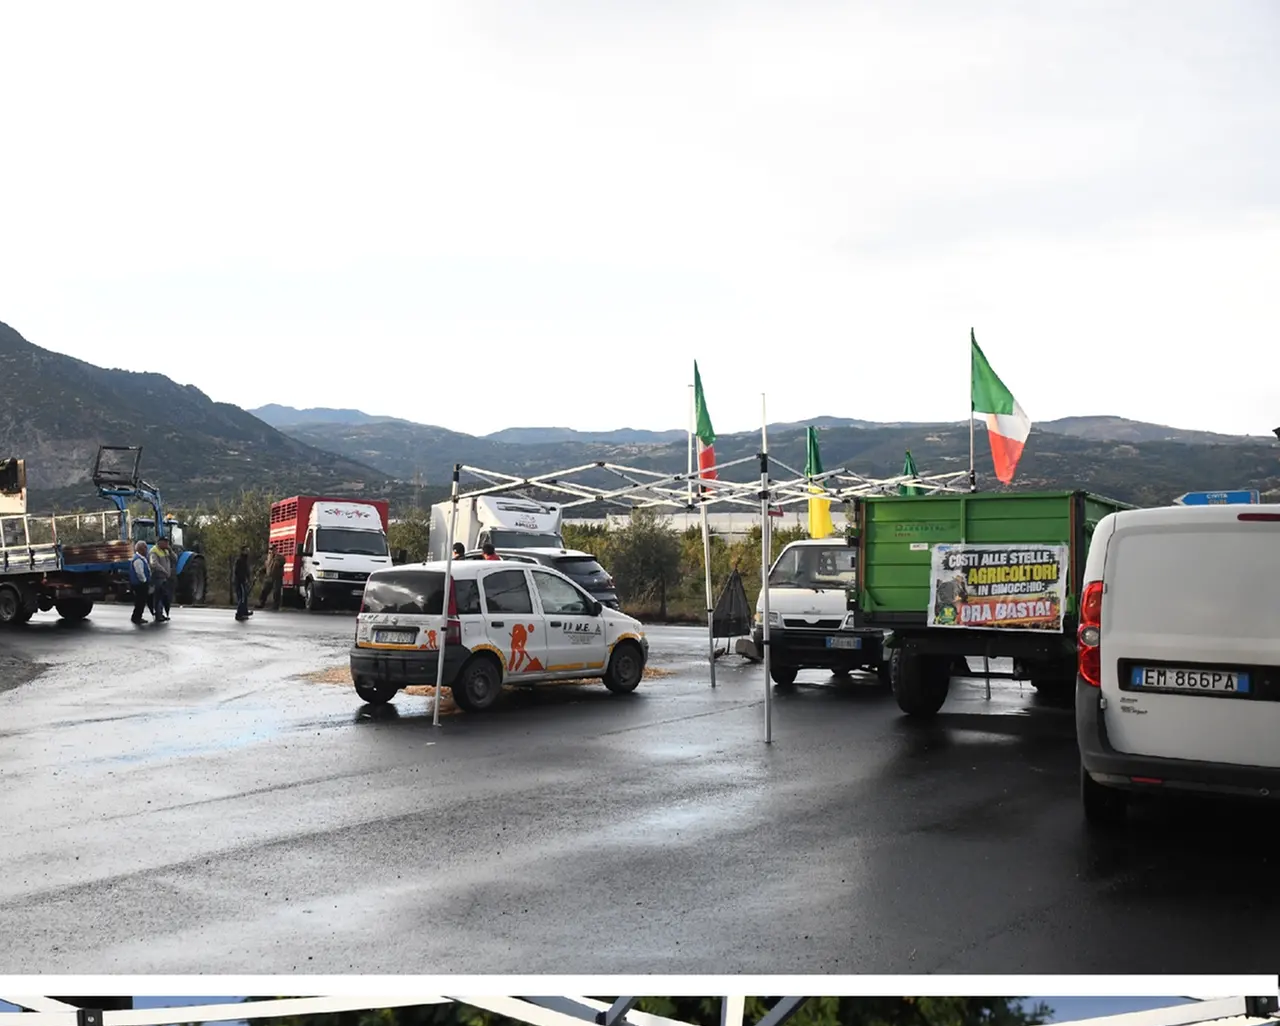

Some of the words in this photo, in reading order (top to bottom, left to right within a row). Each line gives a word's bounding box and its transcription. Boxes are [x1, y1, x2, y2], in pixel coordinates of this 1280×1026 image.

[948, 553, 978, 568] COSTI
[981, 552, 1008, 567] ALLE
[968, 564, 1058, 585] AGRICOLTORI
[978, 585, 989, 595] IN
[960, 603, 992, 623] ORA
[995, 601, 1052, 620] BASTA!
